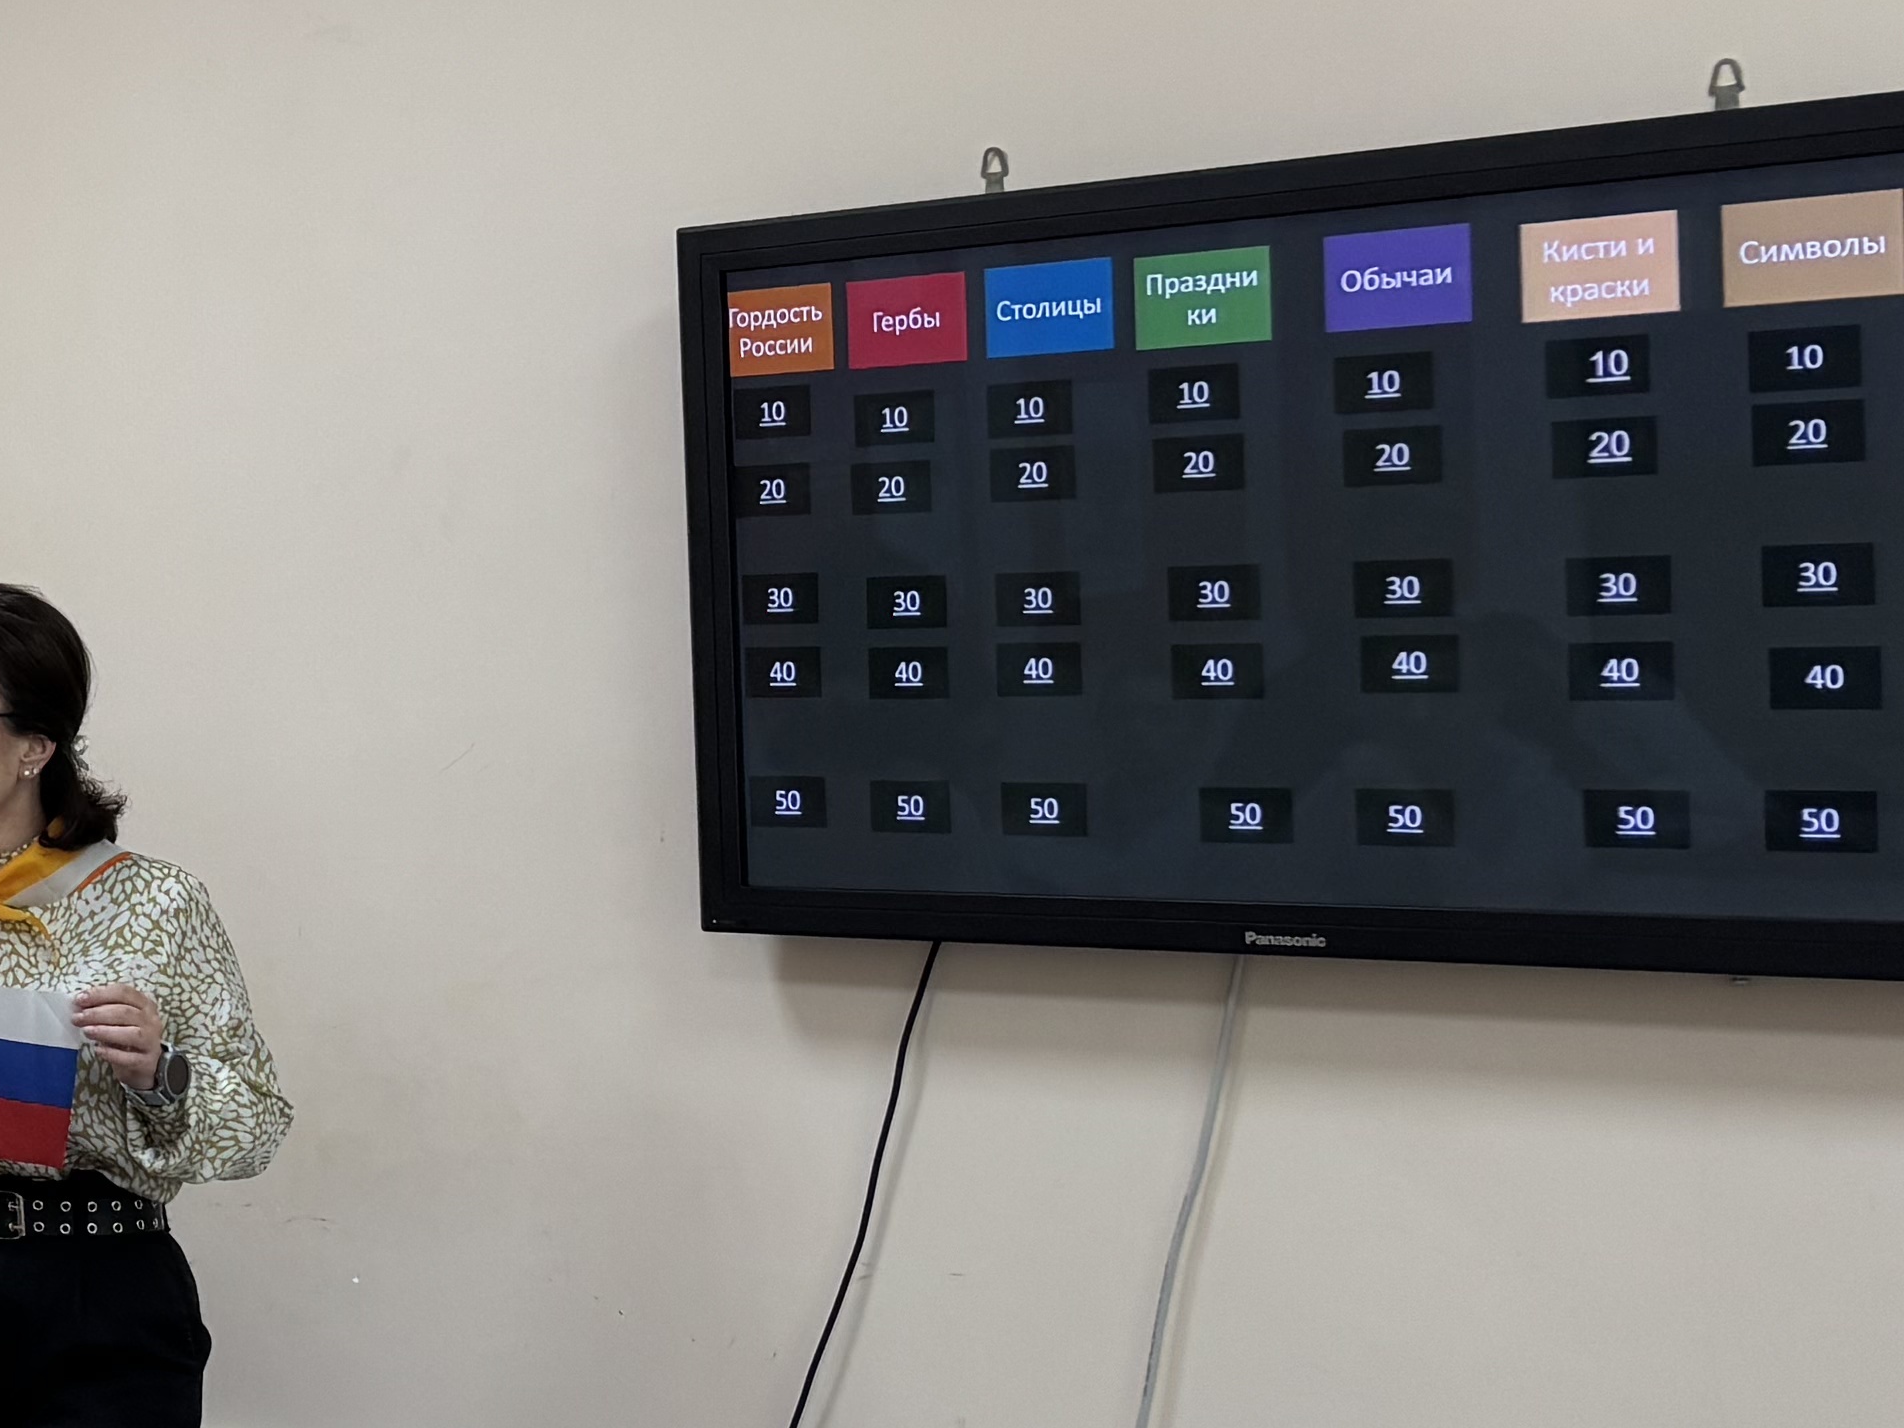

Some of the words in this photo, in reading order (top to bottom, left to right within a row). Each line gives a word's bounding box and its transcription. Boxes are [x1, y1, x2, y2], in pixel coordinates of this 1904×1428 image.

[1542, 236, 1628, 264] Кисти
[1637, 236, 1656, 256] и
[1739, 234, 1887, 266] Символы
[1145, 266, 1259, 297] Праздни
[1340, 263, 1453, 293] Обычаи
[1549, 276, 1651, 309] краски
[728, 303, 823, 330] Гордость
[872, 307, 941, 335] Гербы
[996, 296, 1102, 324] Столицы
[1187, 307, 1218, 326] ки
[739, 335, 813, 359] России
[1785, 344, 1824, 371] 10
[1585, 349, 1632, 384] 10
[1176, 380, 1211, 410] 10
[1364, 369, 1402, 400] 10
[758, 400, 787, 428] 10
[880, 405, 910, 433] 10
[1013, 396, 1046, 425] 10
[1586, 429, 1633, 464] 20
[1786, 418, 1829, 450] 20
[1181, 450, 1217, 479] 20
[1373, 442, 1412, 472] 20
[876, 475, 907, 503] 20
[1017, 461, 1049, 489] 20
[759, 478, 787, 505] 20
[1383, 575, 1422, 605] 30
[1596, 572, 1639, 603] 30
[1796, 561, 1839, 593] 30
[766, 586, 795, 613] 30
[892, 590, 922, 617] 30
[1022, 586, 1054, 614] 30
[1196, 580, 1232, 609] 30
[769, 660, 797, 687] 40
[894, 660, 924, 687] 40
[1022, 657, 1055, 684] 40
[1200, 658, 1235, 686] 40
[1391, 650, 1429, 680] 40
[1599, 657, 1641, 688] 40
[1804, 664, 1845, 690] 40
[774, 789, 803, 815] 50
[896, 794, 926, 821] 50
[1028, 797, 1061, 825] 50
[1228, 802, 1264, 831] 50
[1386, 804, 1425, 834] 50
[1615, 805, 1657, 836] 50
[1798, 807, 1842, 839] 50
[1245, 931, 1327, 948] Panasonic
